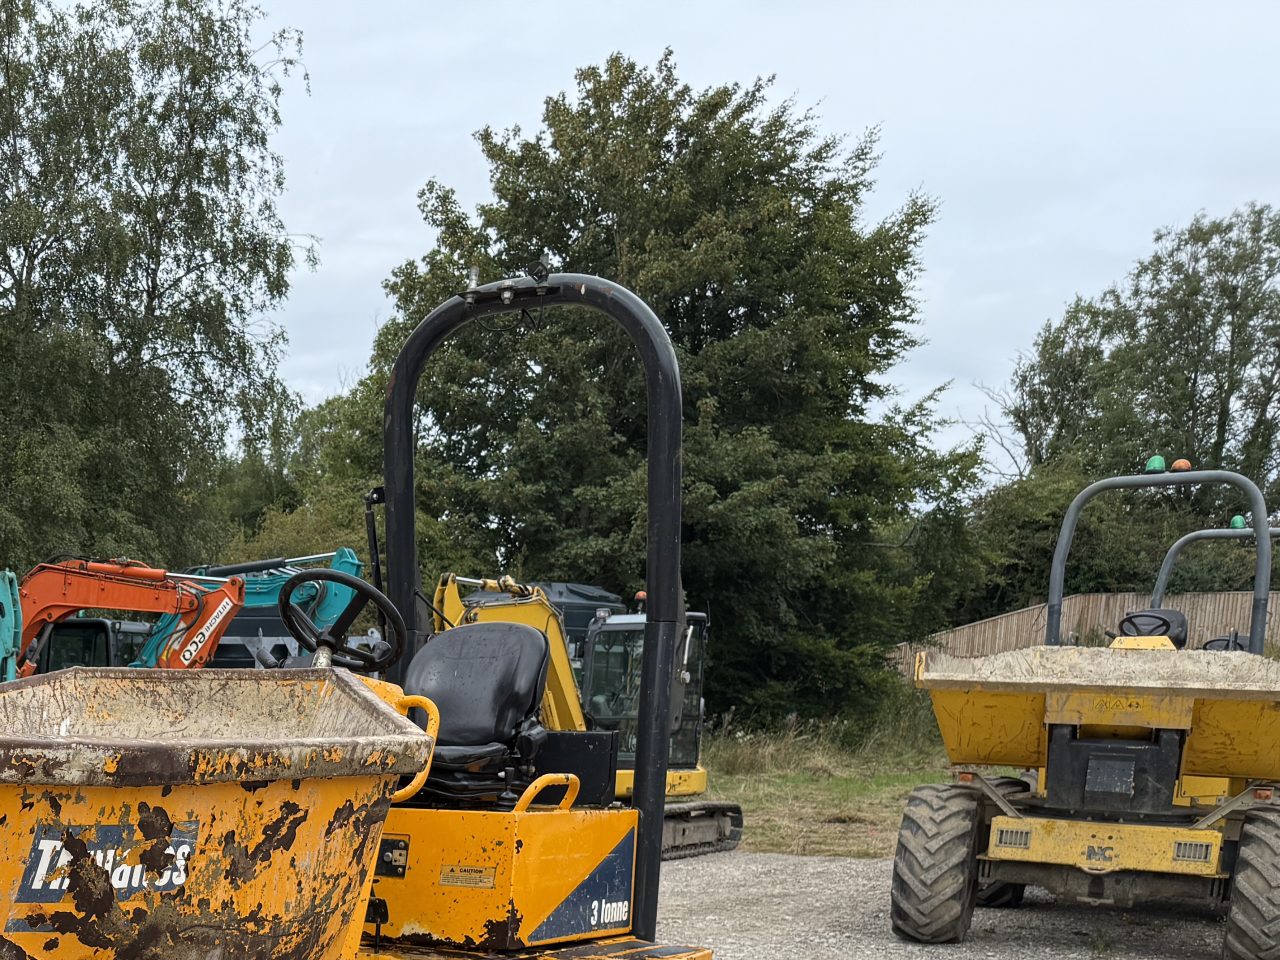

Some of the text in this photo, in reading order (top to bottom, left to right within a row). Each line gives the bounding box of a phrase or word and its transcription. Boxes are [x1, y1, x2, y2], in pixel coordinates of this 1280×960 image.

[205, 601, 230, 633] HITACHI
[590, 899, 629, 925] 3 tonne
